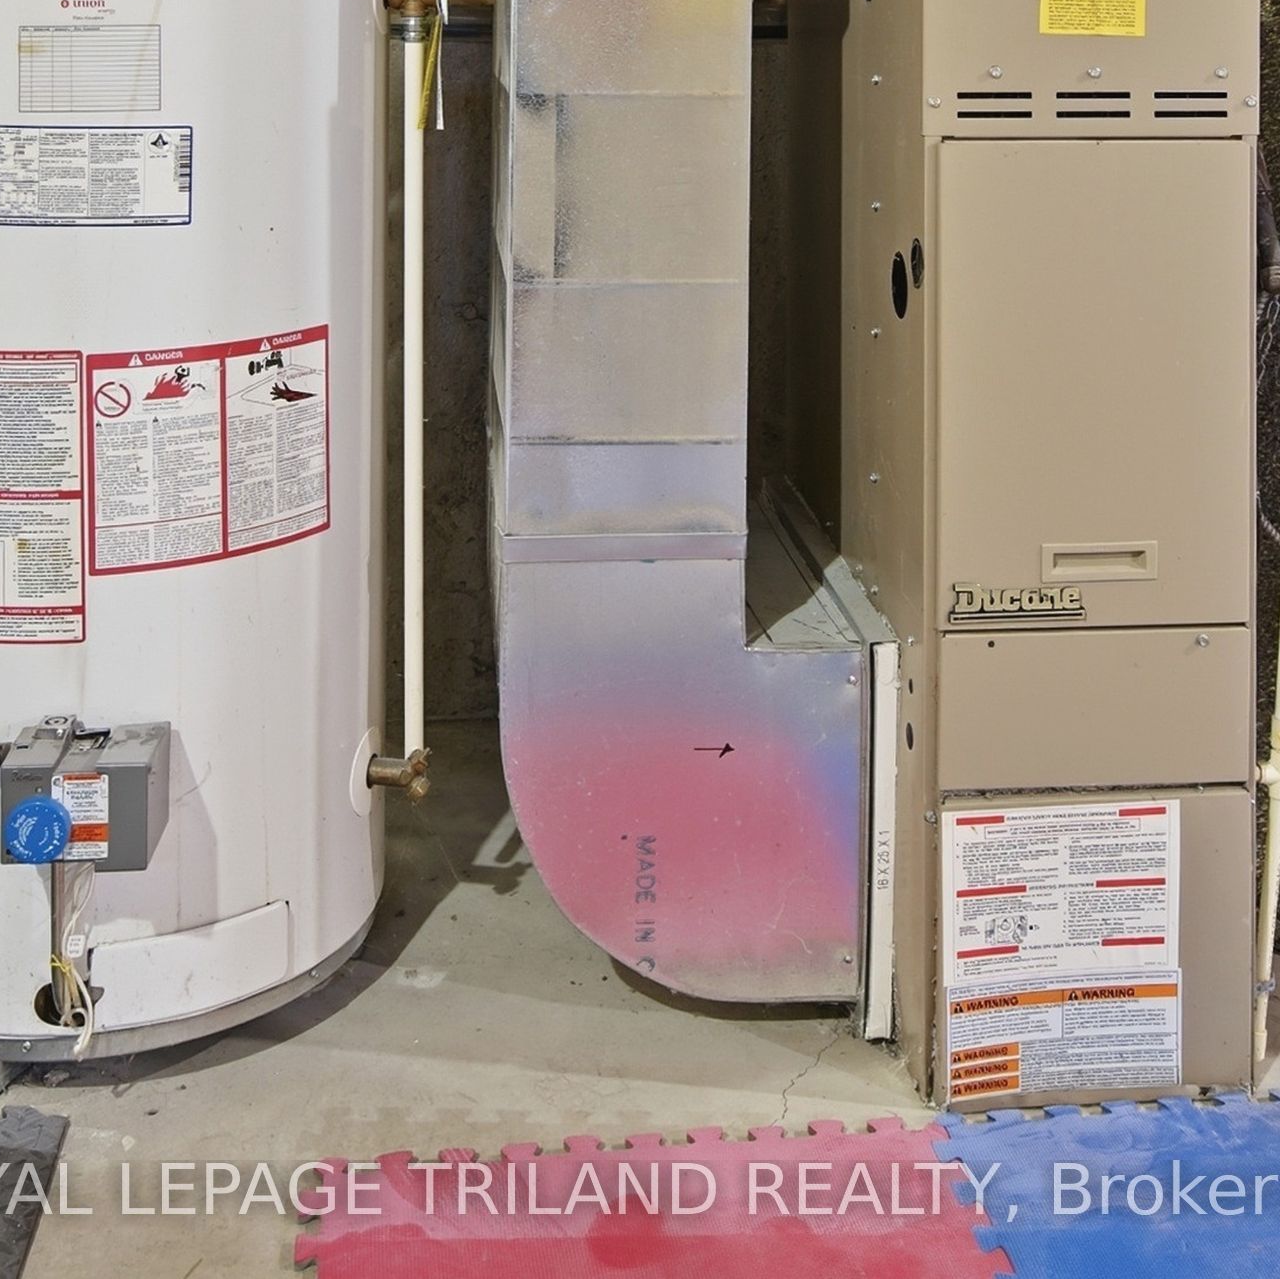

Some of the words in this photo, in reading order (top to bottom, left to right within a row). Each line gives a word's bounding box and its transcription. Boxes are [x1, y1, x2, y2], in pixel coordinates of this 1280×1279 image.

[144, 350, 184, 362] DANGER
[952, 582, 1083, 614] Ducane
[877, 839, 890, 848] X
[634, 835, 657, 904] MADE
[877, 867, 890, 876] X
[634, 919, 656, 943] IN
[1080, 987, 1136, 1002] WARNING
[965, 996, 1020, 1013] WARNING
